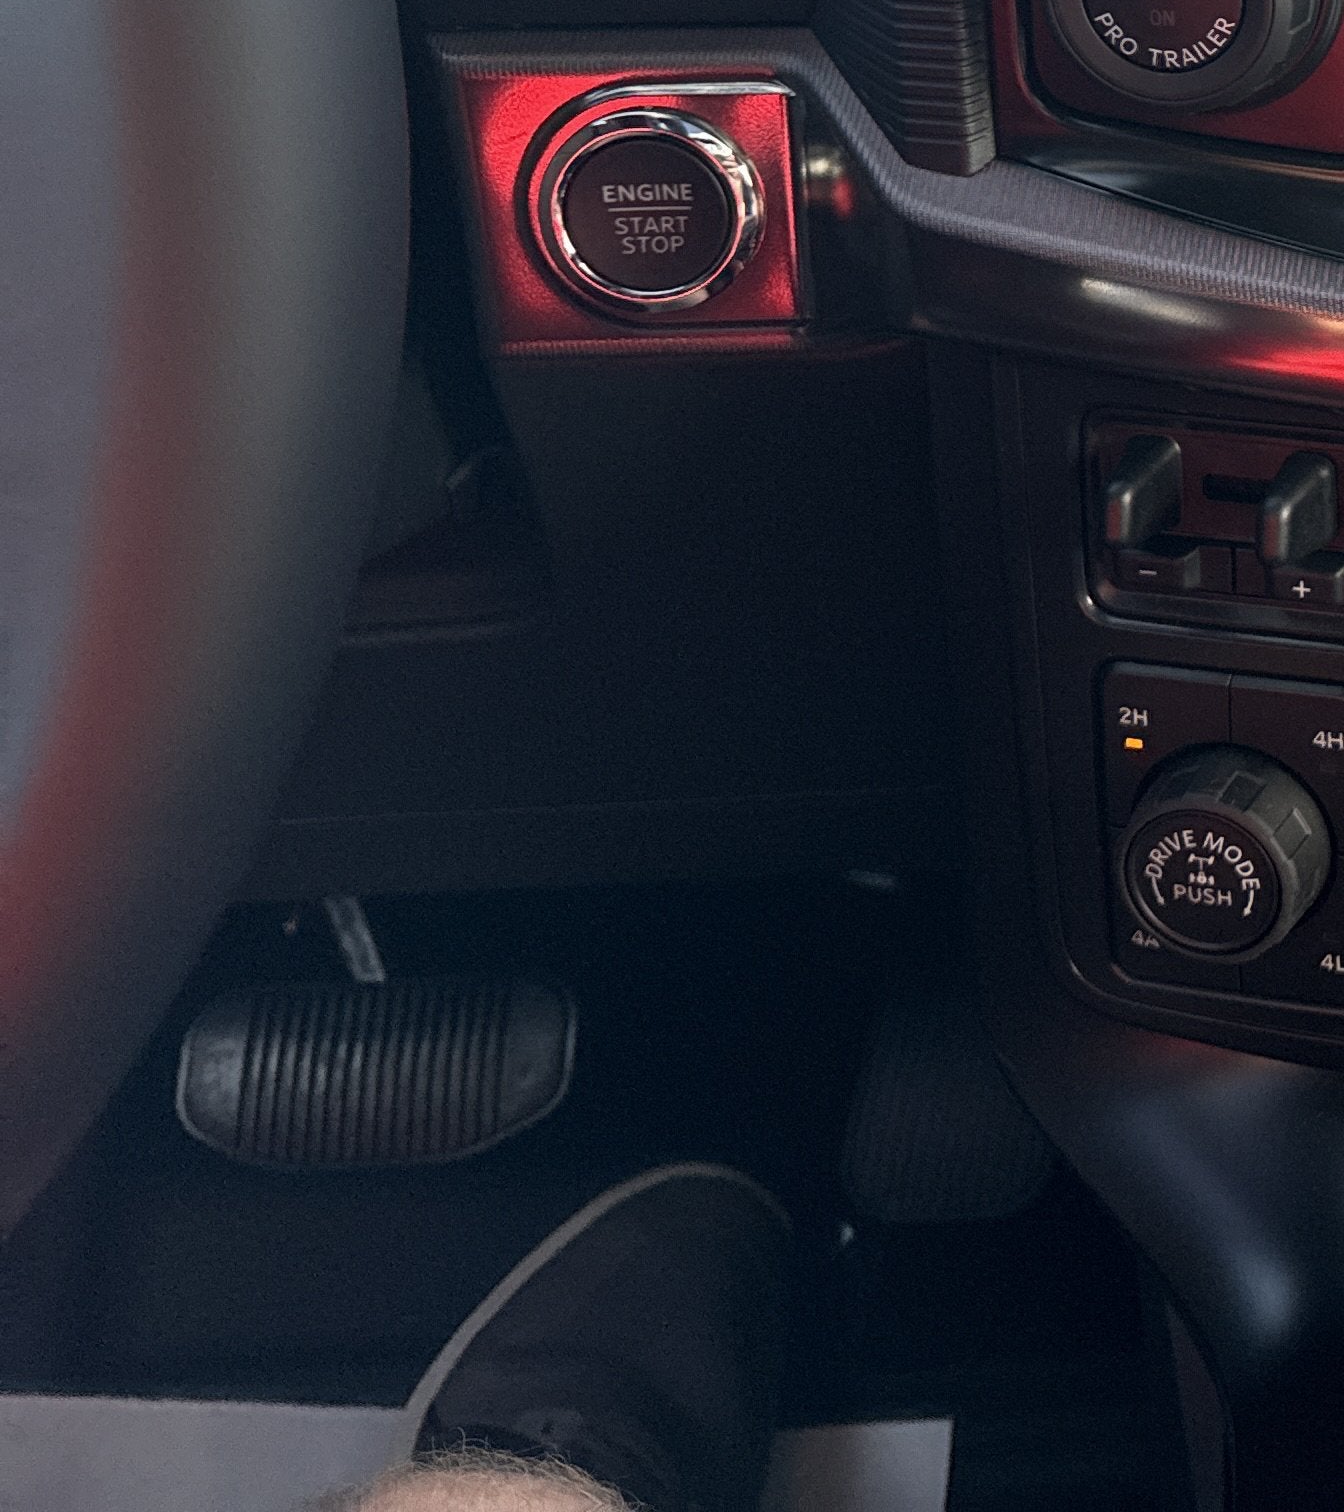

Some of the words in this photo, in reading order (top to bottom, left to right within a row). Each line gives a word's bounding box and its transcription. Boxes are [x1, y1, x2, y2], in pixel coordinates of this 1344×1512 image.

[1149, 9, 1177, 28] ON
[1094, 11, 1139, 58] PRO
[1148, 15, 1237, 68] TRAILER
[602, 182, 694, 204] ENGINE
[614, 215, 689, 236] START
[621, 234, 685, 254] STOP
[1118, 707, 1150, 727] 2H
[1312, 730, 1344, 751] 4H
[1145, 828, 1197, 881] DRIVE
[1203, 832, 1261, 892] MODE
[1173, 884, 1233, 908] PUSH
